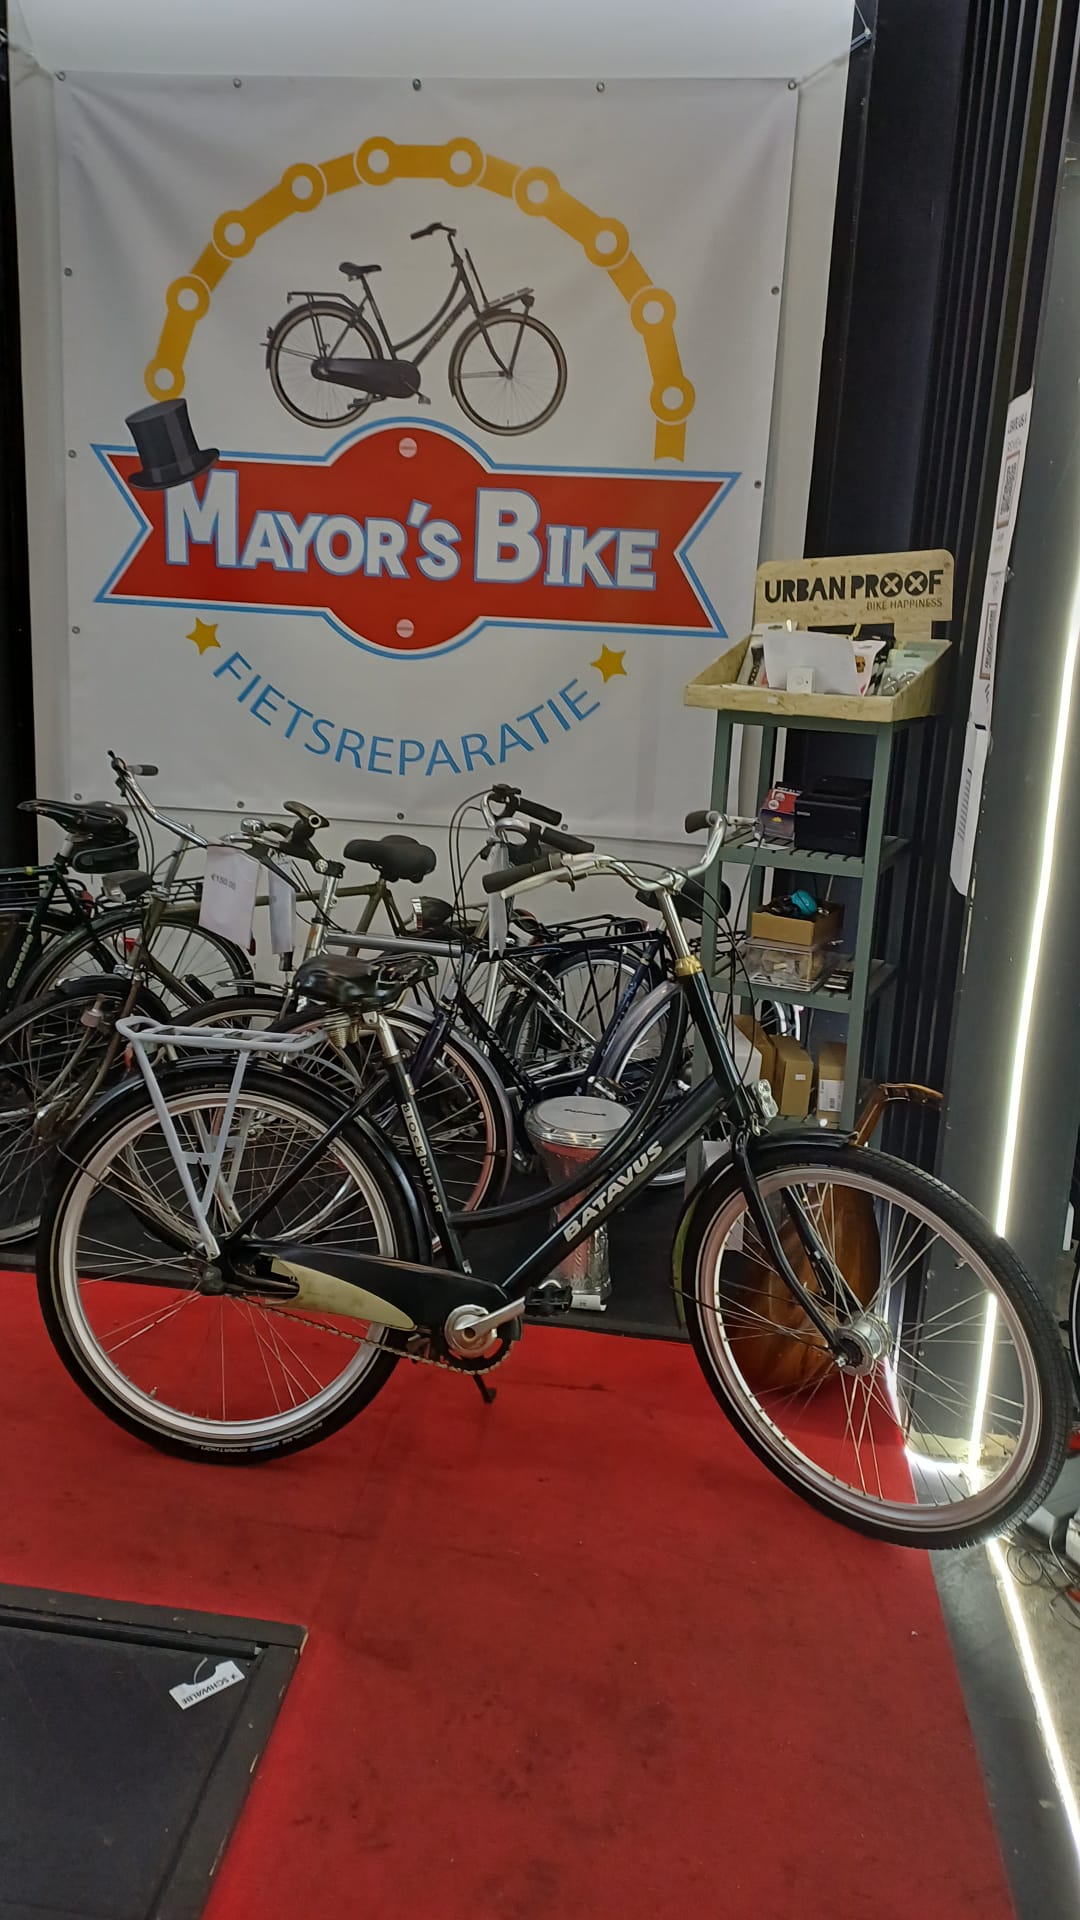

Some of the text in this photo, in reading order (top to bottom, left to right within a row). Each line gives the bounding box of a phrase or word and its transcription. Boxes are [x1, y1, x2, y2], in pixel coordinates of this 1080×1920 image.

[165, 469, 659, 591] MAYOR'S BIKE
[765, 569, 944, 603] URBAN PROOF
[866, 597, 943, 611] BIKE HAPPINESS
[213, 651, 601, 776] FIETSREPARATIE
[563, 1140, 663, 1242] BATAVUS
